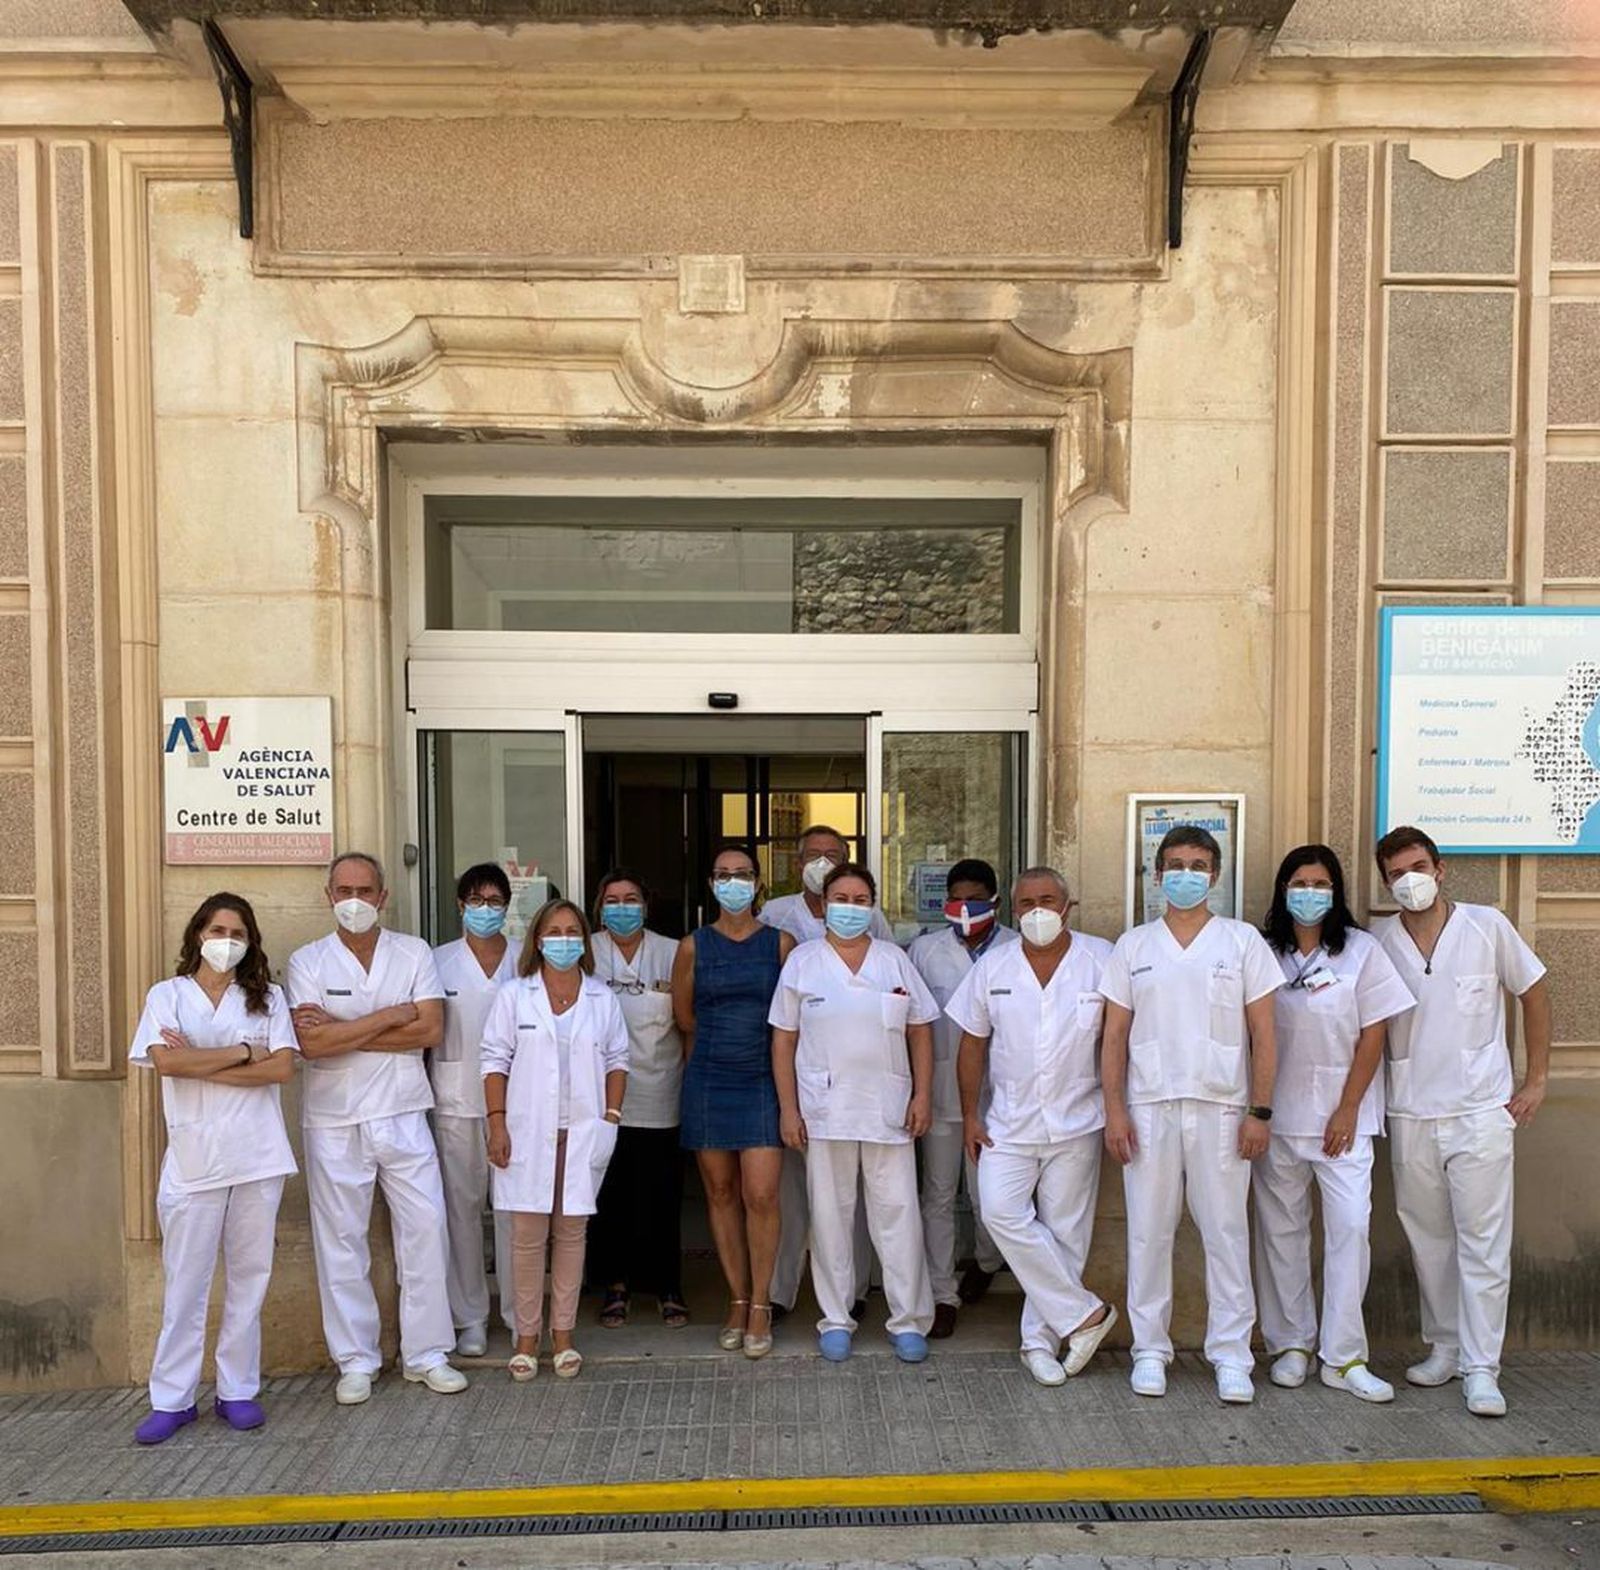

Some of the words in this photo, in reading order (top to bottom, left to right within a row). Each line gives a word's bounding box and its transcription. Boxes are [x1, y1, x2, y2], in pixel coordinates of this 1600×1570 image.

[1419, 699, 1459, 708] Medicina
[1461, 699, 1497, 708] General
[239, 747, 313, 762] AGÈNCIA
[223, 768, 330, 780] VALENCIANA
[237, 785, 258, 796] DE
[264, 784, 315, 796] SALUT
[1468, 784, 1496, 794] Social
[177, 810, 237, 826] Centre
[246, 809, 267, 825] de
[275, 808, 321, 825] Salut
